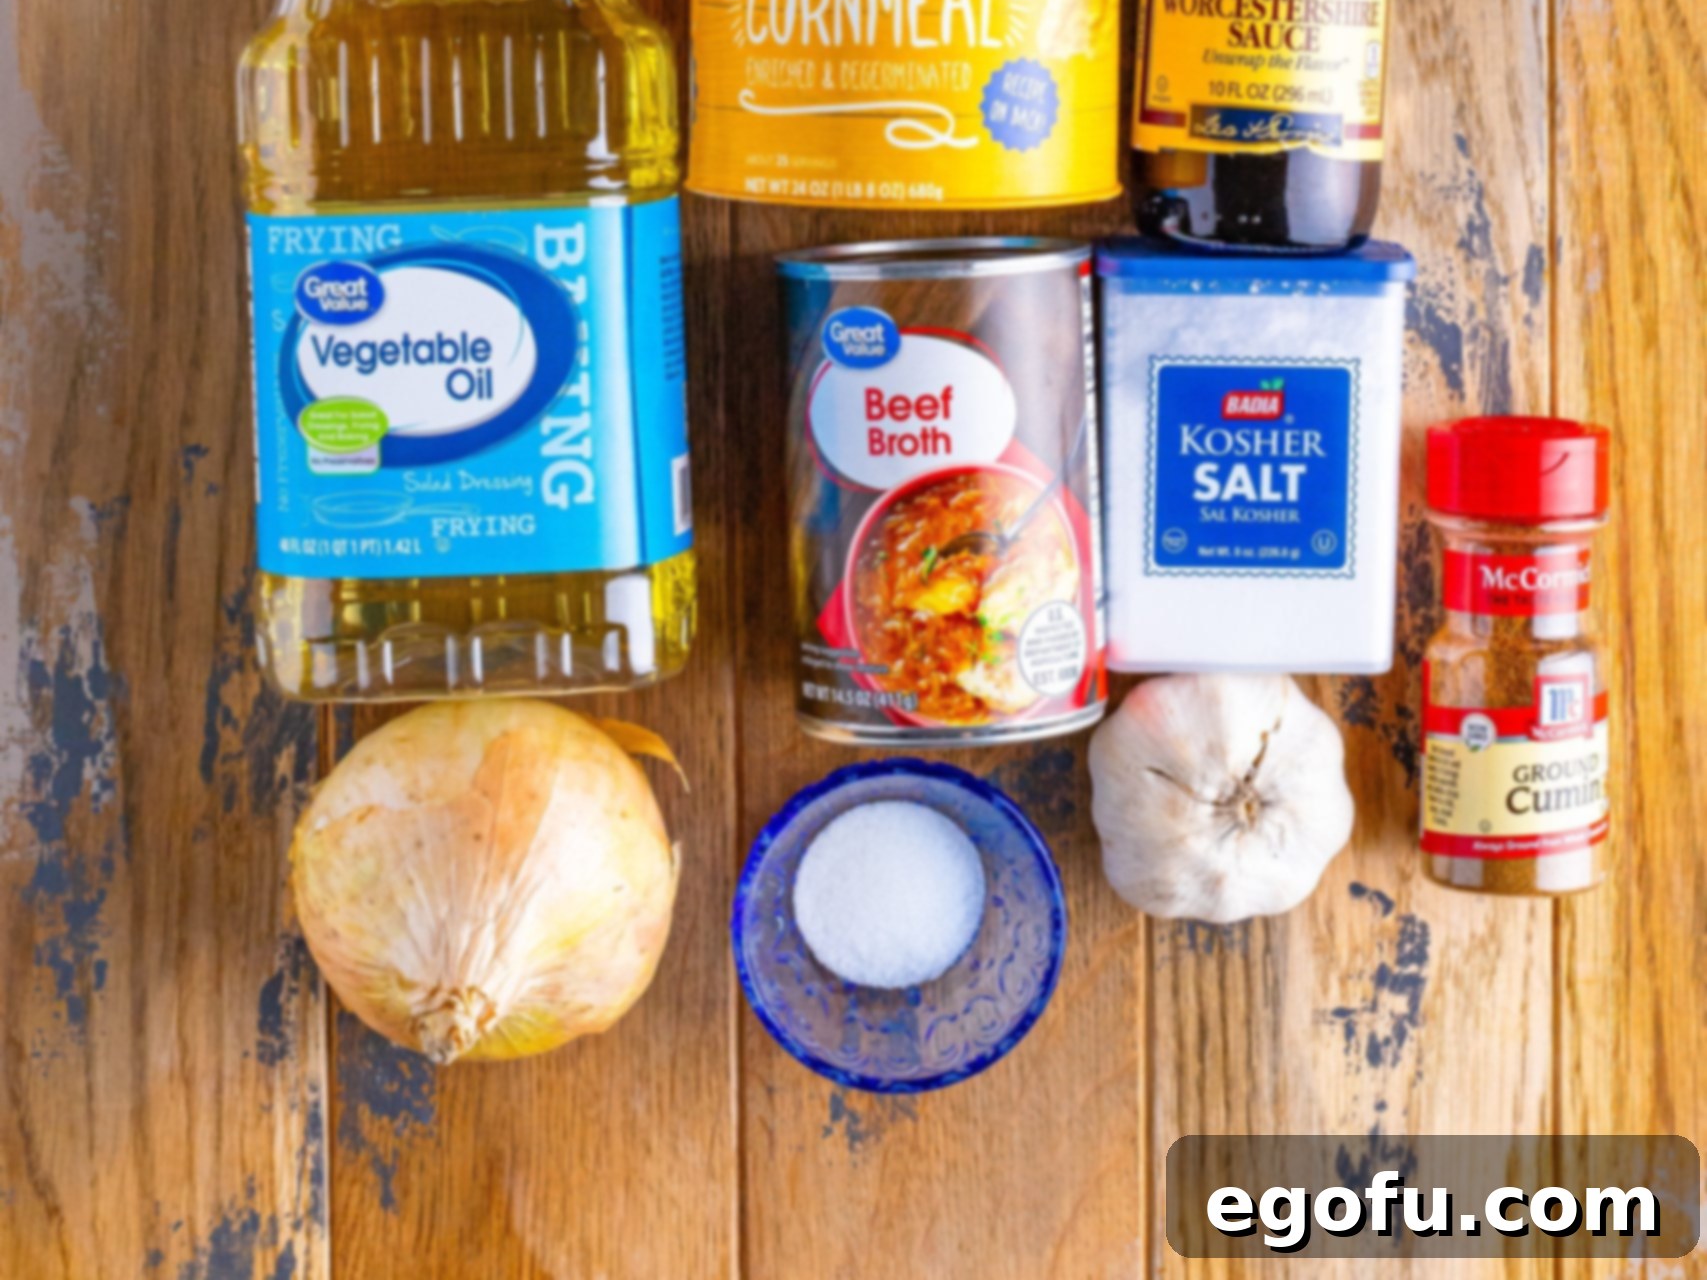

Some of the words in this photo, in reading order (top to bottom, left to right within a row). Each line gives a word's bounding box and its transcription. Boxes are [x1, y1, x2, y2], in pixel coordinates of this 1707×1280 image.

[1227, 21, 1321, 53] SAUCE
[1202, 48, 1265, 70] Unwrap
[1268, 51, 1292, 68] the
[1208, 80, 1226, 97] 10
[1228, 81, 1243, 98] FL
[1246, 82, 1270, 100] OZ
[745, 177, 766, 193] NET
[769, 178, 788, 194] WT
[810, 180, 829, 197] OZ
[267, 223, 402, 255] FRYING
[303, 276, 369, 298] Great
[319, 294, 370, 312] Value
[829, 322, 886, 344] Great
[842, 338, 886, 357] Value
[310, 332, 493, 376] Vegetable
[445, 368, 493, 402] Oil
[864, 385, 954, 422] Beef
[1225, 396, 1280, 415] BADIA
[867, 427, 953, 458] Broth
[1179, 423, 1326, 459] KOSHER
[403, 470, 453, 492] Salad
[457, 469, 533, 497] Dressing
[1192, 462, 1307, 503] SALT
[431, 514, 536, 539] FRYING
[1512, 753, 1599, 784] GROUND
[1505, 778, 1601, 816] Cumin
